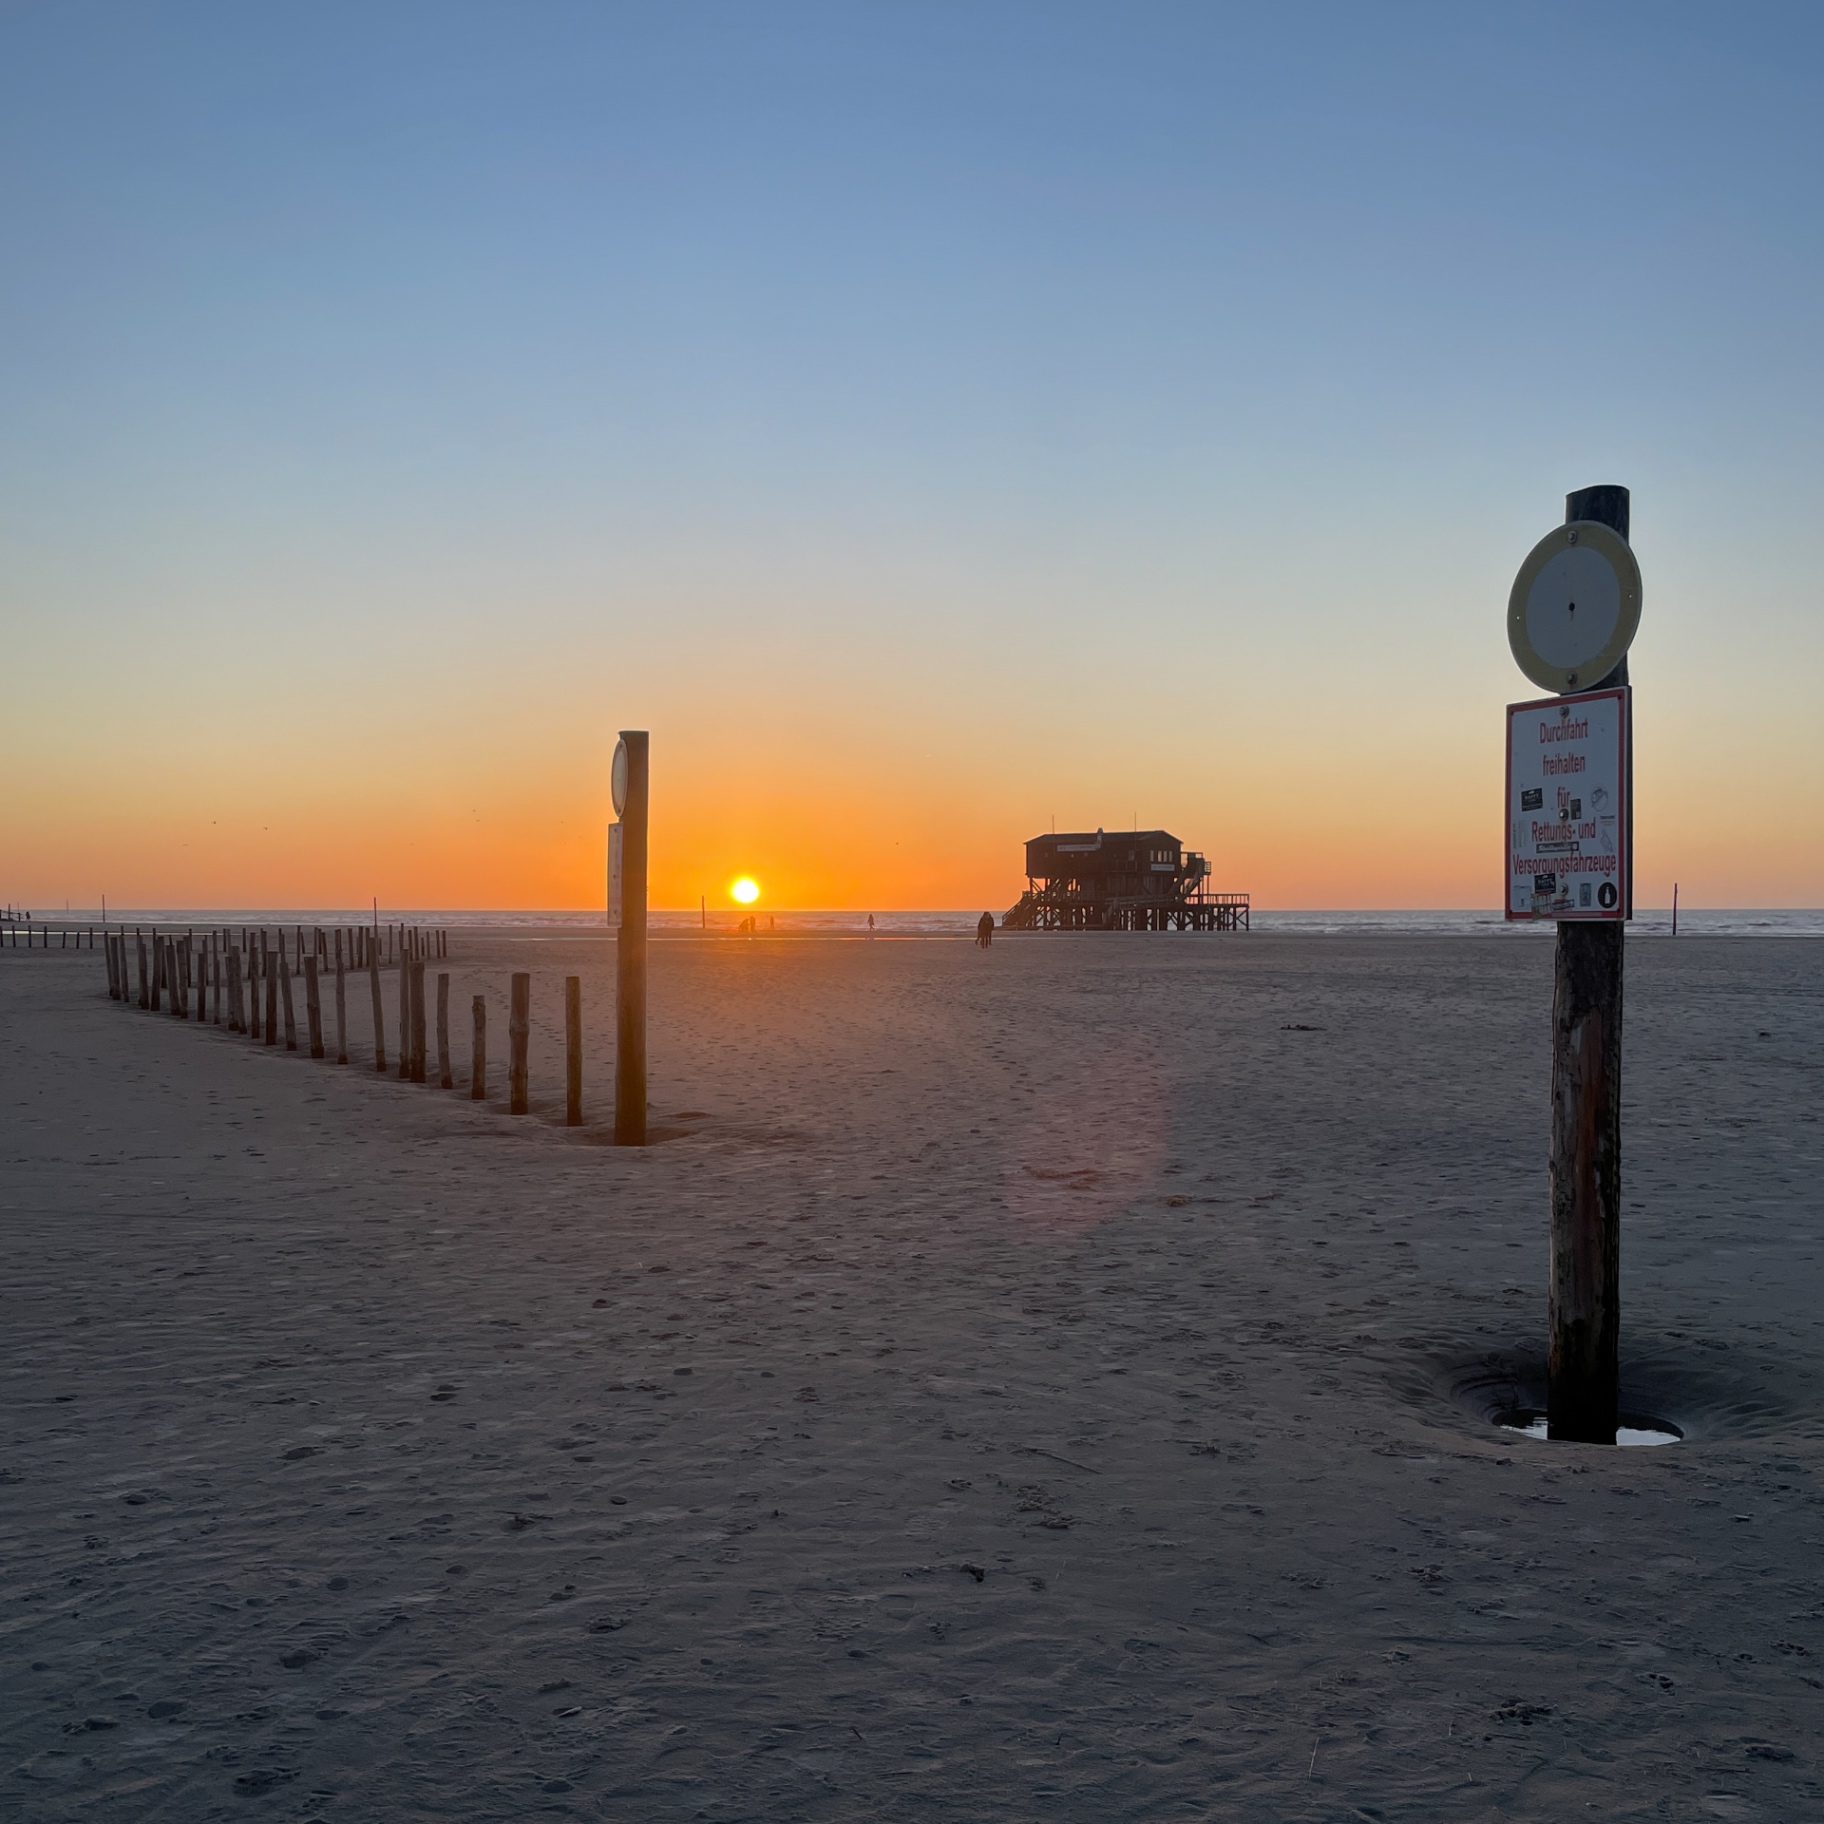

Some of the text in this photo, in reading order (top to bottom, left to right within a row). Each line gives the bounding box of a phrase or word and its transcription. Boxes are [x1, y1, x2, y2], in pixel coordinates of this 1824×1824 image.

[1540, 718, 1588, 743] Durchfahrt
[1543, 752, 1586, 776] freihalten
[1557, 786, 1570, 808] für
[1531, 820, 1576, 843] Rettungs-
[1578, 816, 1596, 839] und
[1513, 850, 1616, 878] Versorgungsfahrzeuge
